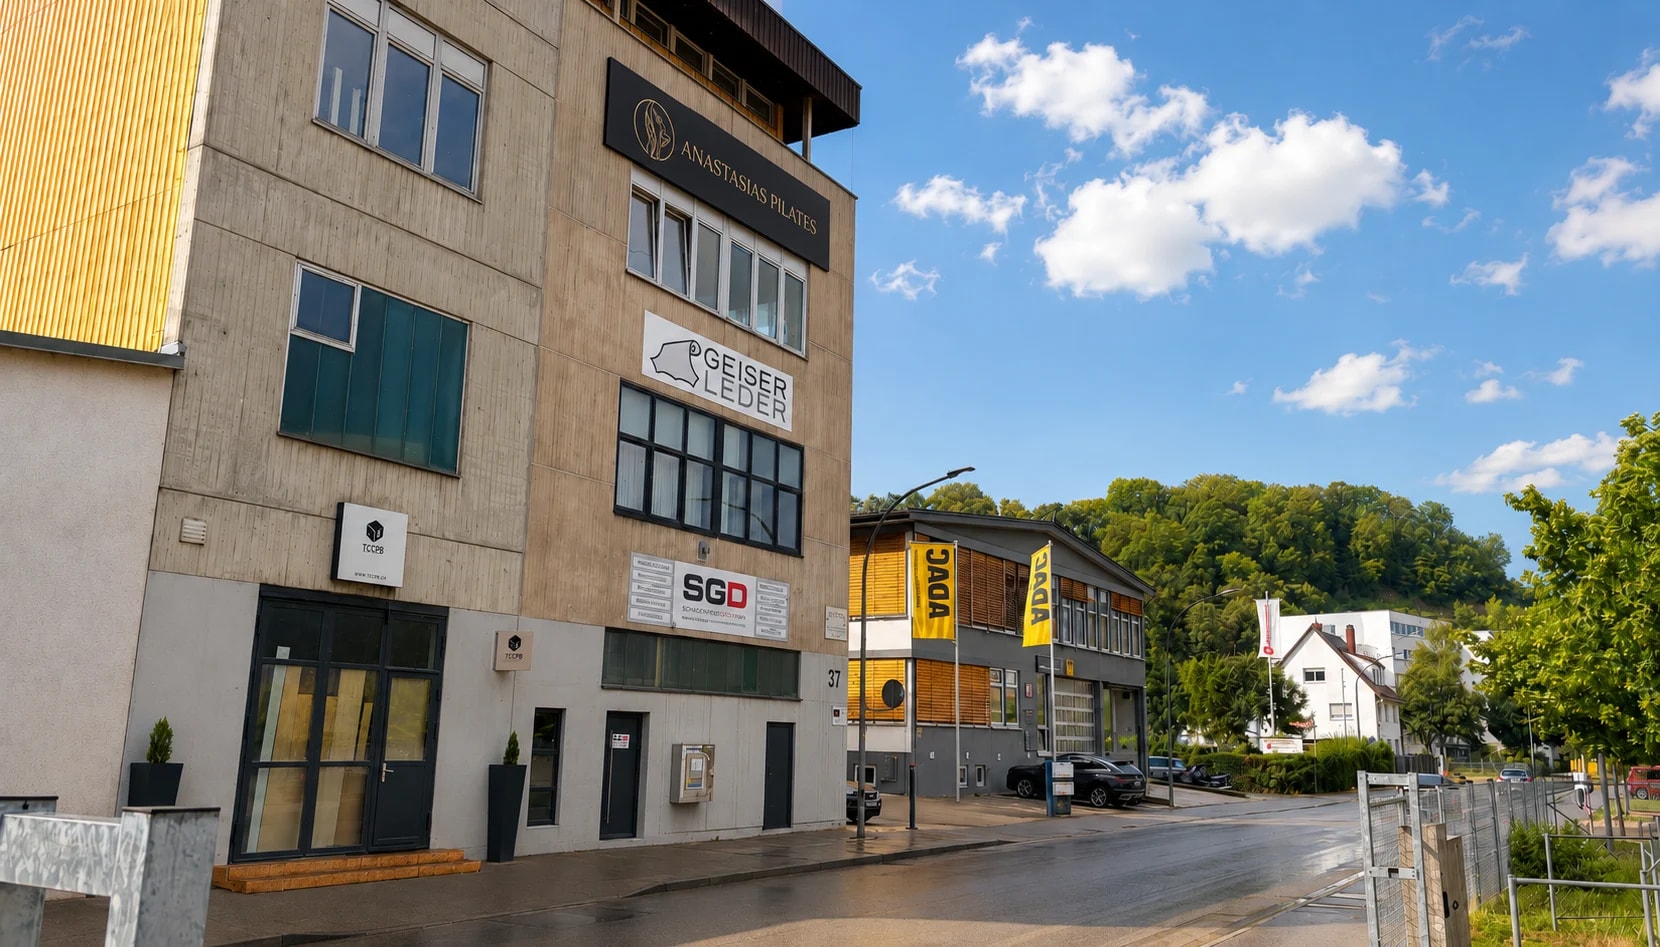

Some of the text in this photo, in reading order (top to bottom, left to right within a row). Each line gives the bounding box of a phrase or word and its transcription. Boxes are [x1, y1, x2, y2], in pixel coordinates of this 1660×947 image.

[681, 141, 817, 234] ANASTASIAS PILATES
[704, 348, 787, 400] GEISER
[704, 370, 786, 423] LEDER
[683, 573, 748, 609] SGD
[828, 669, 841, 688] 37
